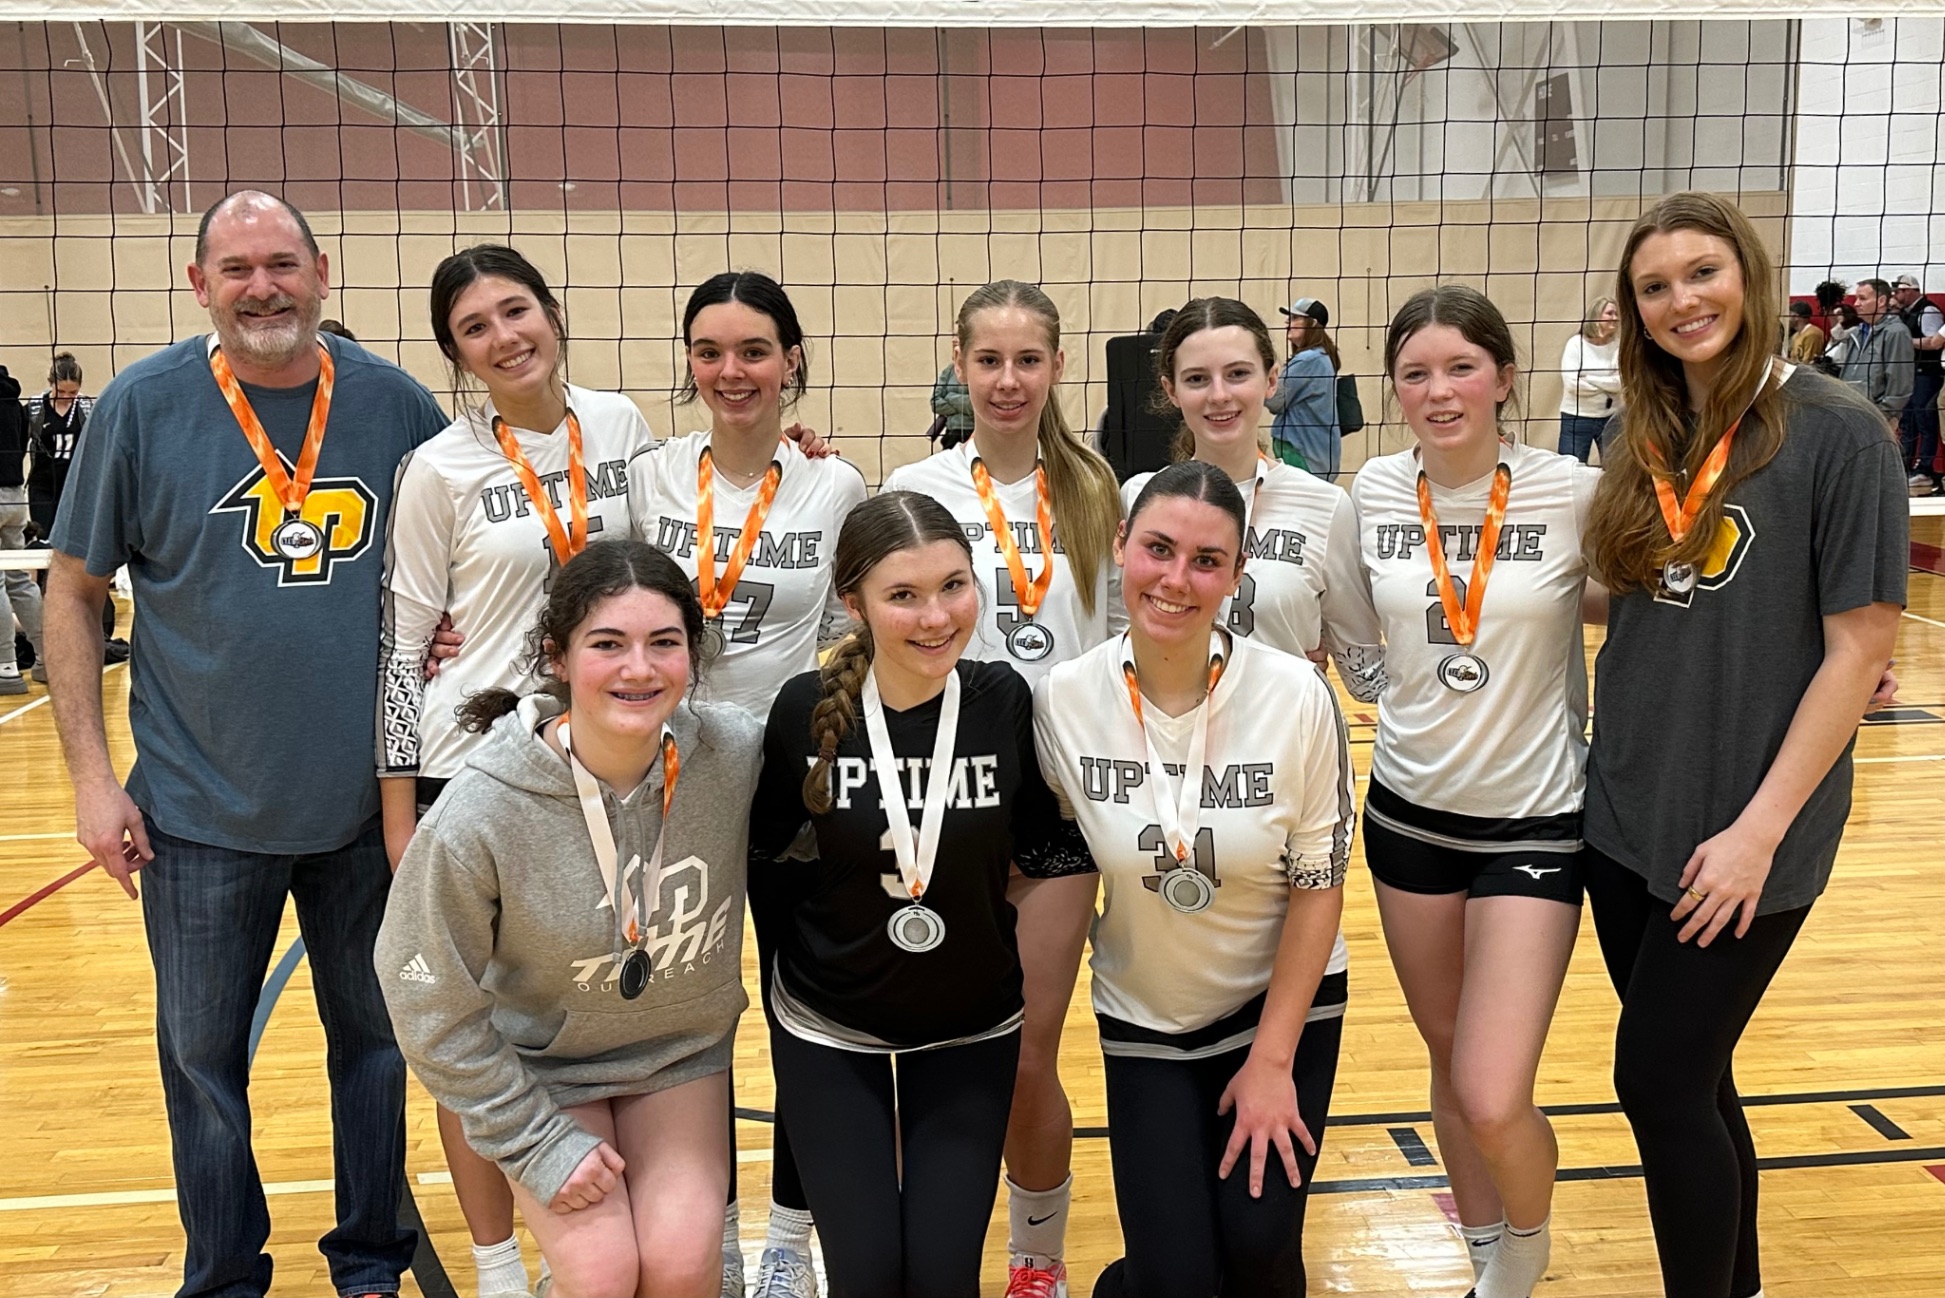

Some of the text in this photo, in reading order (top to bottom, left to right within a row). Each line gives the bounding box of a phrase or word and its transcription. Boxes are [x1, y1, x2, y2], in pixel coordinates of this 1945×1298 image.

[481, 459, 629, 524] UPTME
[656, 516, 823, 569] UPTME
[1080, 756, 1274, 809] UPME
[1138, 824, 1221, 893] 31
[399, 970, 436, 984] adidas
[577, 939, 724, 993] OUREACH
